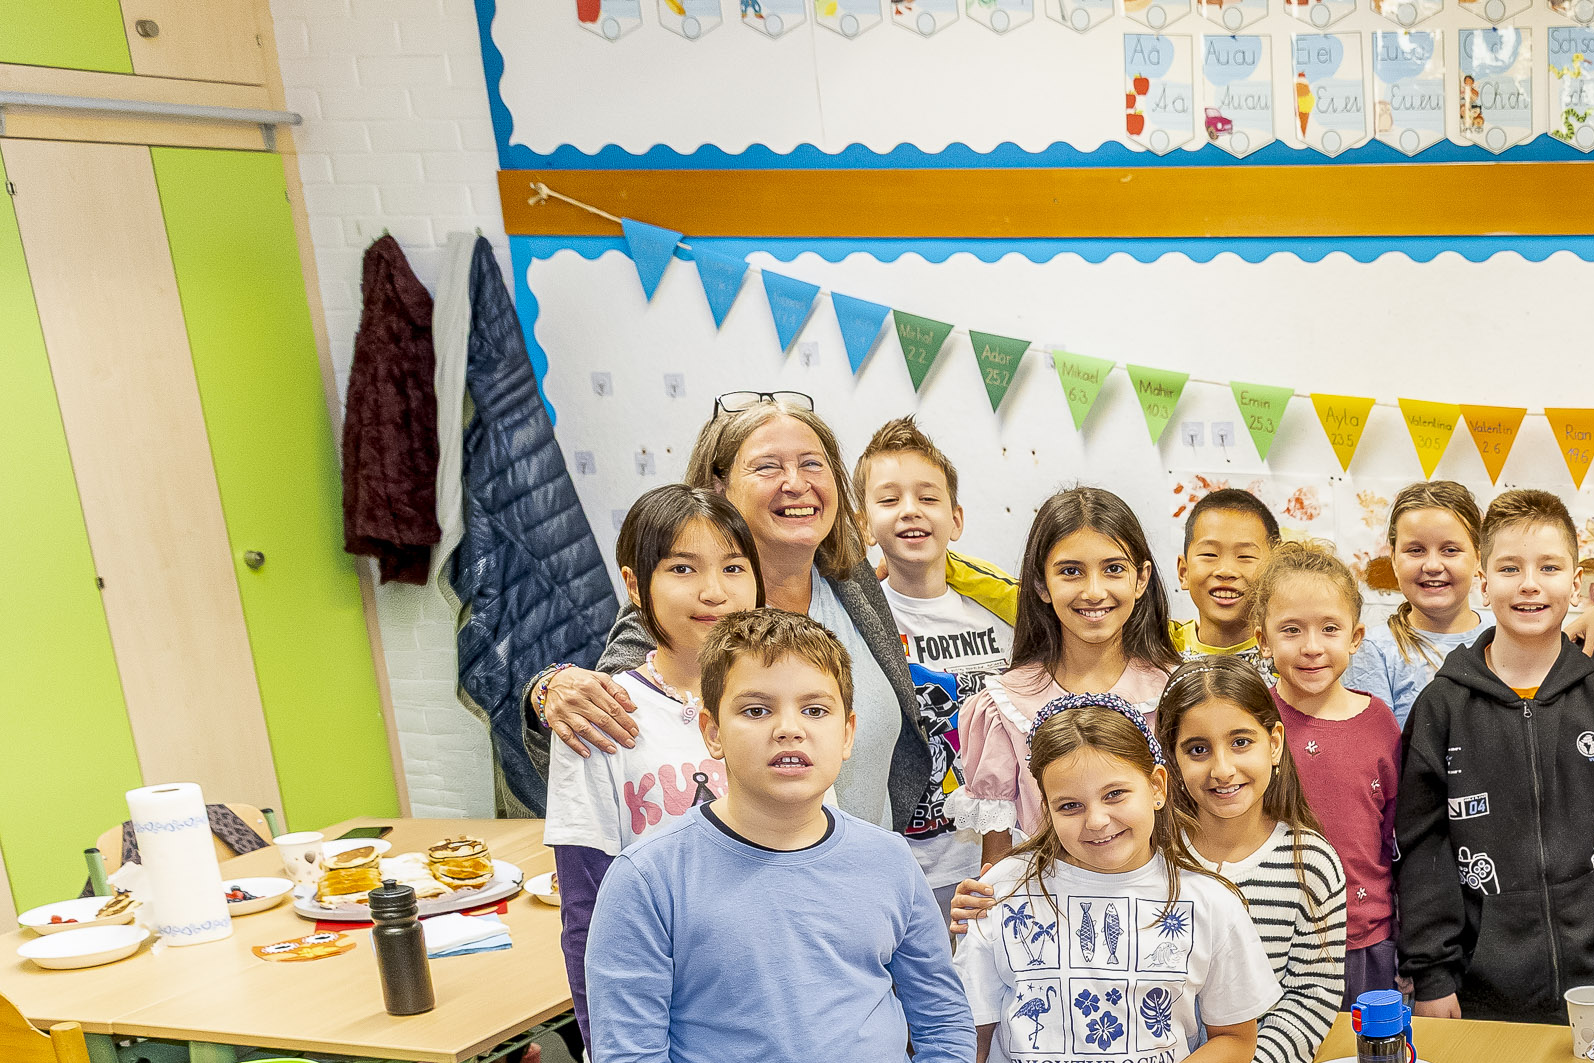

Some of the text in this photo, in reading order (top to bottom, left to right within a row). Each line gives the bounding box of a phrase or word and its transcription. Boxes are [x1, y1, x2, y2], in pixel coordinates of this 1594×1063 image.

[1240, 390, 1271, 409] Emin
[1326, 406, 1359, 430] Ayla
[1470, 420, 1512, 435] Valentin
[914, 626, 1000, 663] FORTNITE
[1469, 799, 1486, 815] 04
